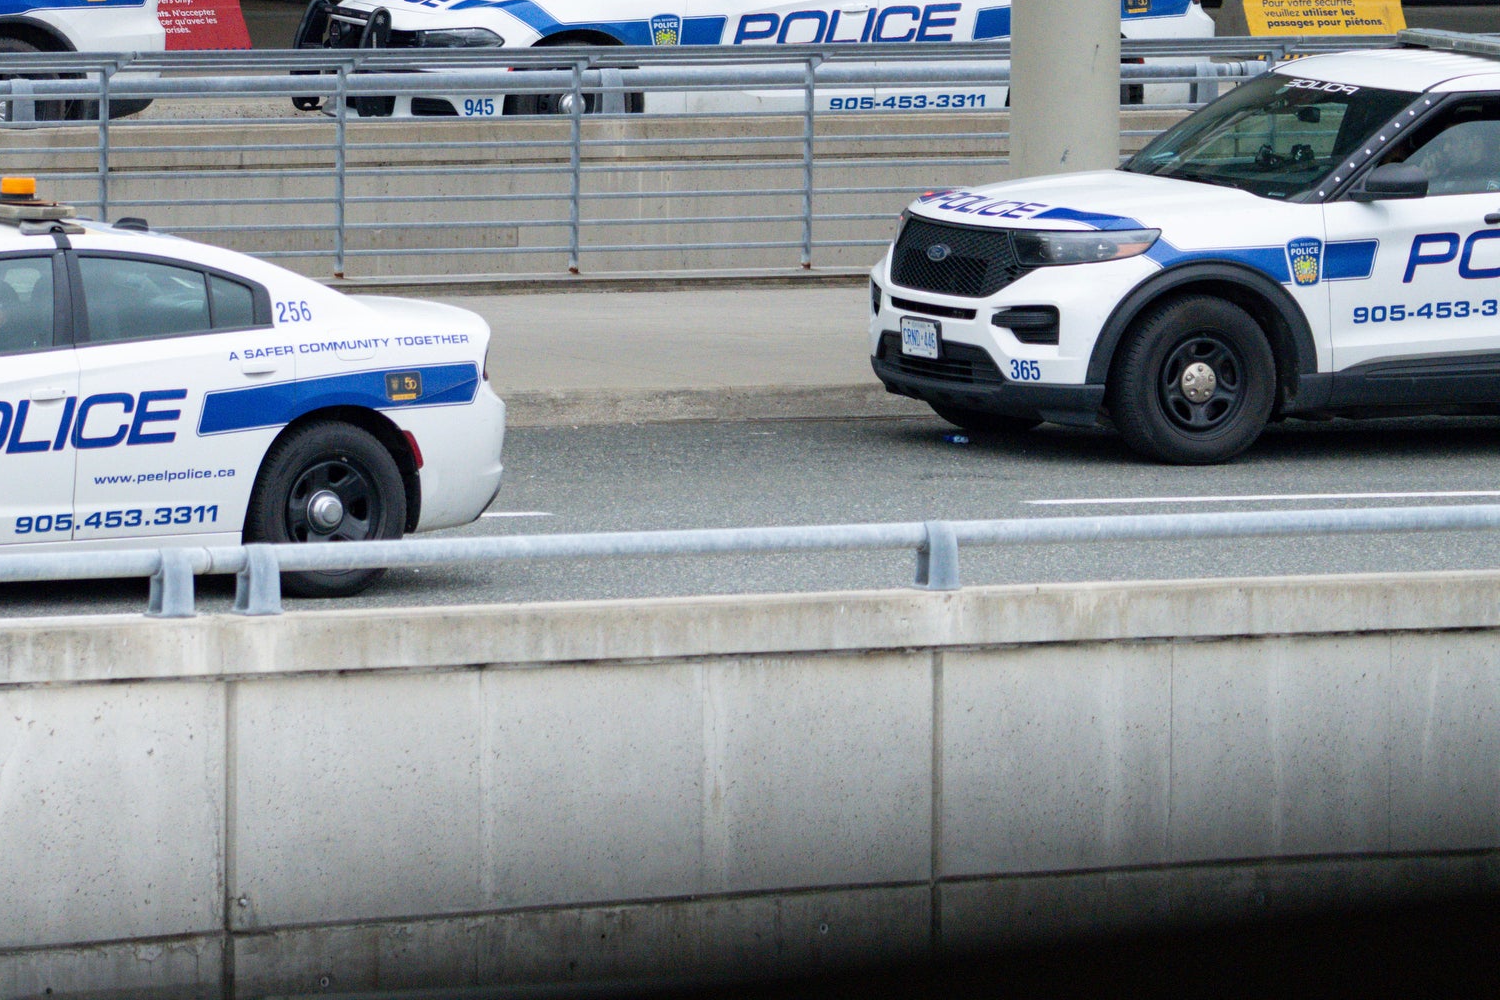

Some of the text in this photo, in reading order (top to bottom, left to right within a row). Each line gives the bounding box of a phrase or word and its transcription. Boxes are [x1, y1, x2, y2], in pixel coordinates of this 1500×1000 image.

[172, 9, 216, 18] N'acceptez
[1264, 7, 1356, 17] veuillez utiliser les
[174, 18, 206, 28] qu'avec
[206, 17, 218, 25] les
[653, 21, 679, 29] POLICE
[733, 2, 962, 44] POLICE
[1267, 16, 1385, 29] passages pour piétons.
[464, 98, 494, 116] 945
[829, 94, 986, 110] 905-453-3311
[1290, 246, 1320, 256] POLICE
[275, 300, 313, 324] 256
[1353, 299, 1499, 324] 905-453-3
[228, 333, 470, 362] A SAFER COMMUNITY TOGETHER
[1010, 359, 1041, 381] 365
[93, 467, 236, 487] www.peelpolice.ca
[15, 505, 220, 534] 905.453.3311
